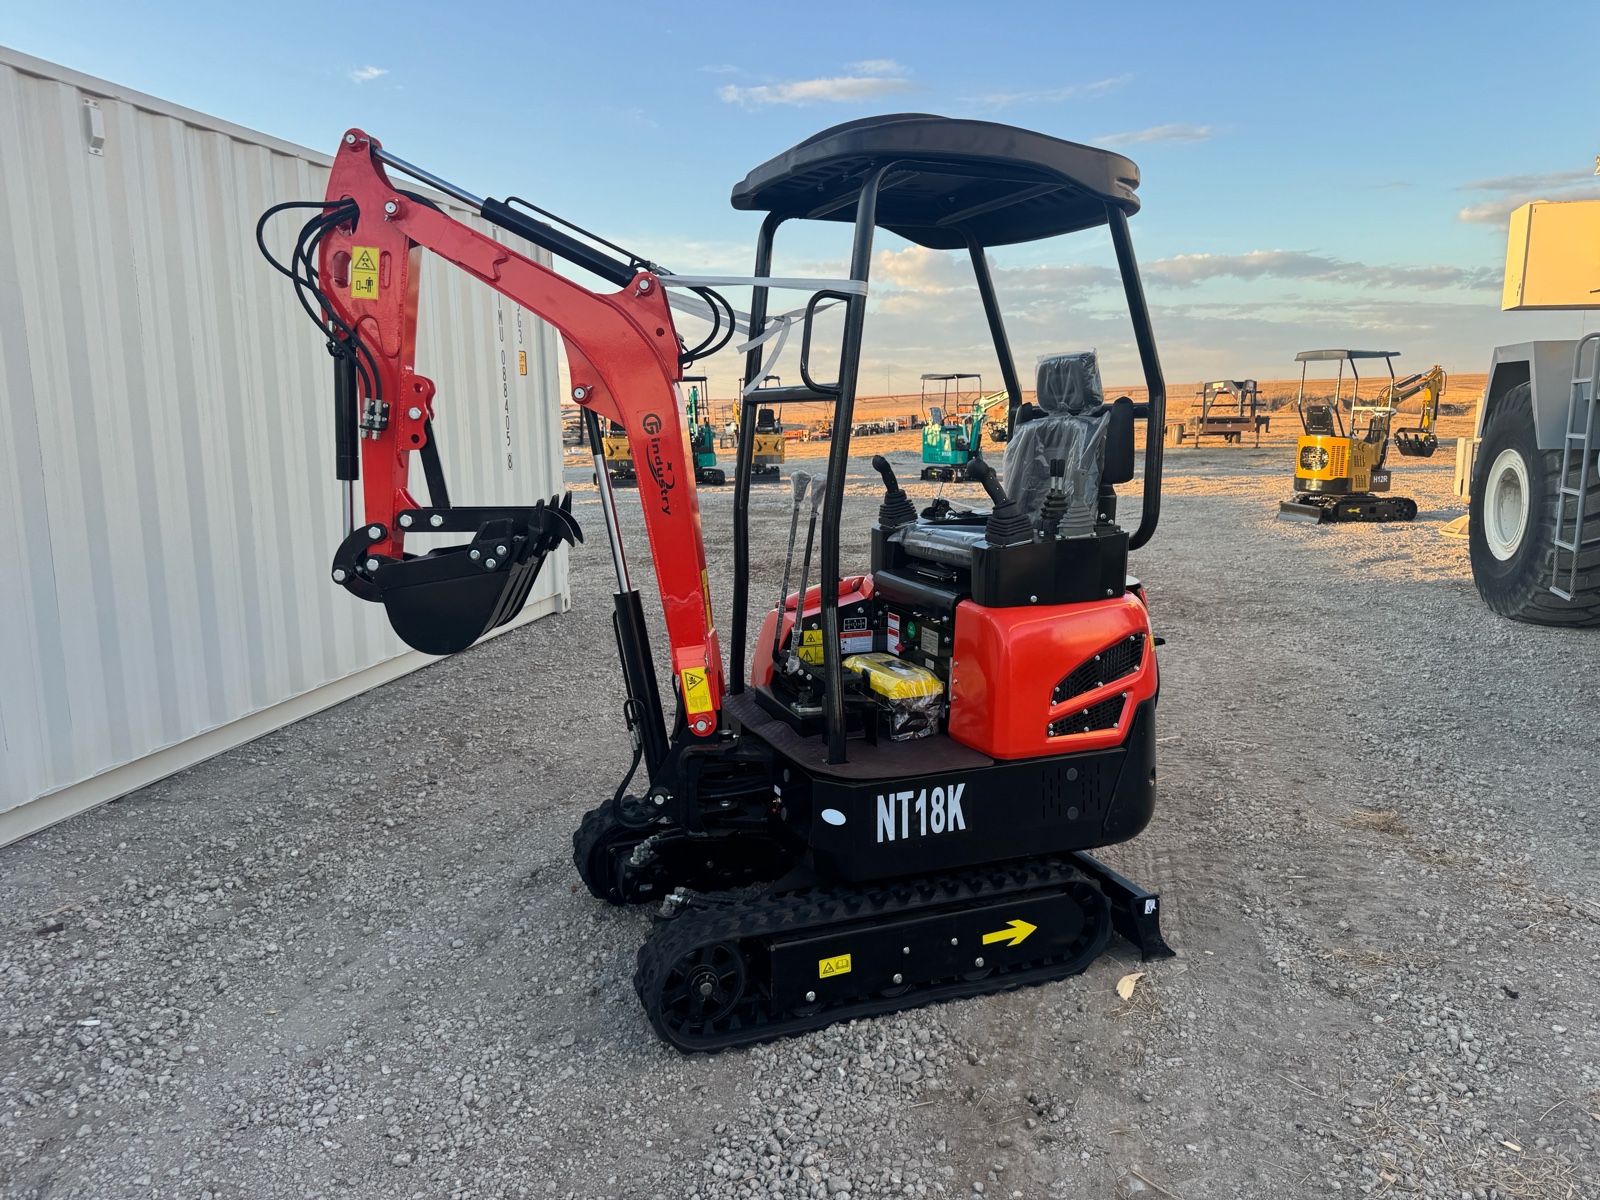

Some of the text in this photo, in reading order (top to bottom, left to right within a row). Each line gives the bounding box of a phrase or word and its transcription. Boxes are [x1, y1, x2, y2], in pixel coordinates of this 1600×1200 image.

[501, 350, 511, 446] 088405
[1373, 475, 1388, 483] H12R
[877, 783, 966, 843] NT18K
